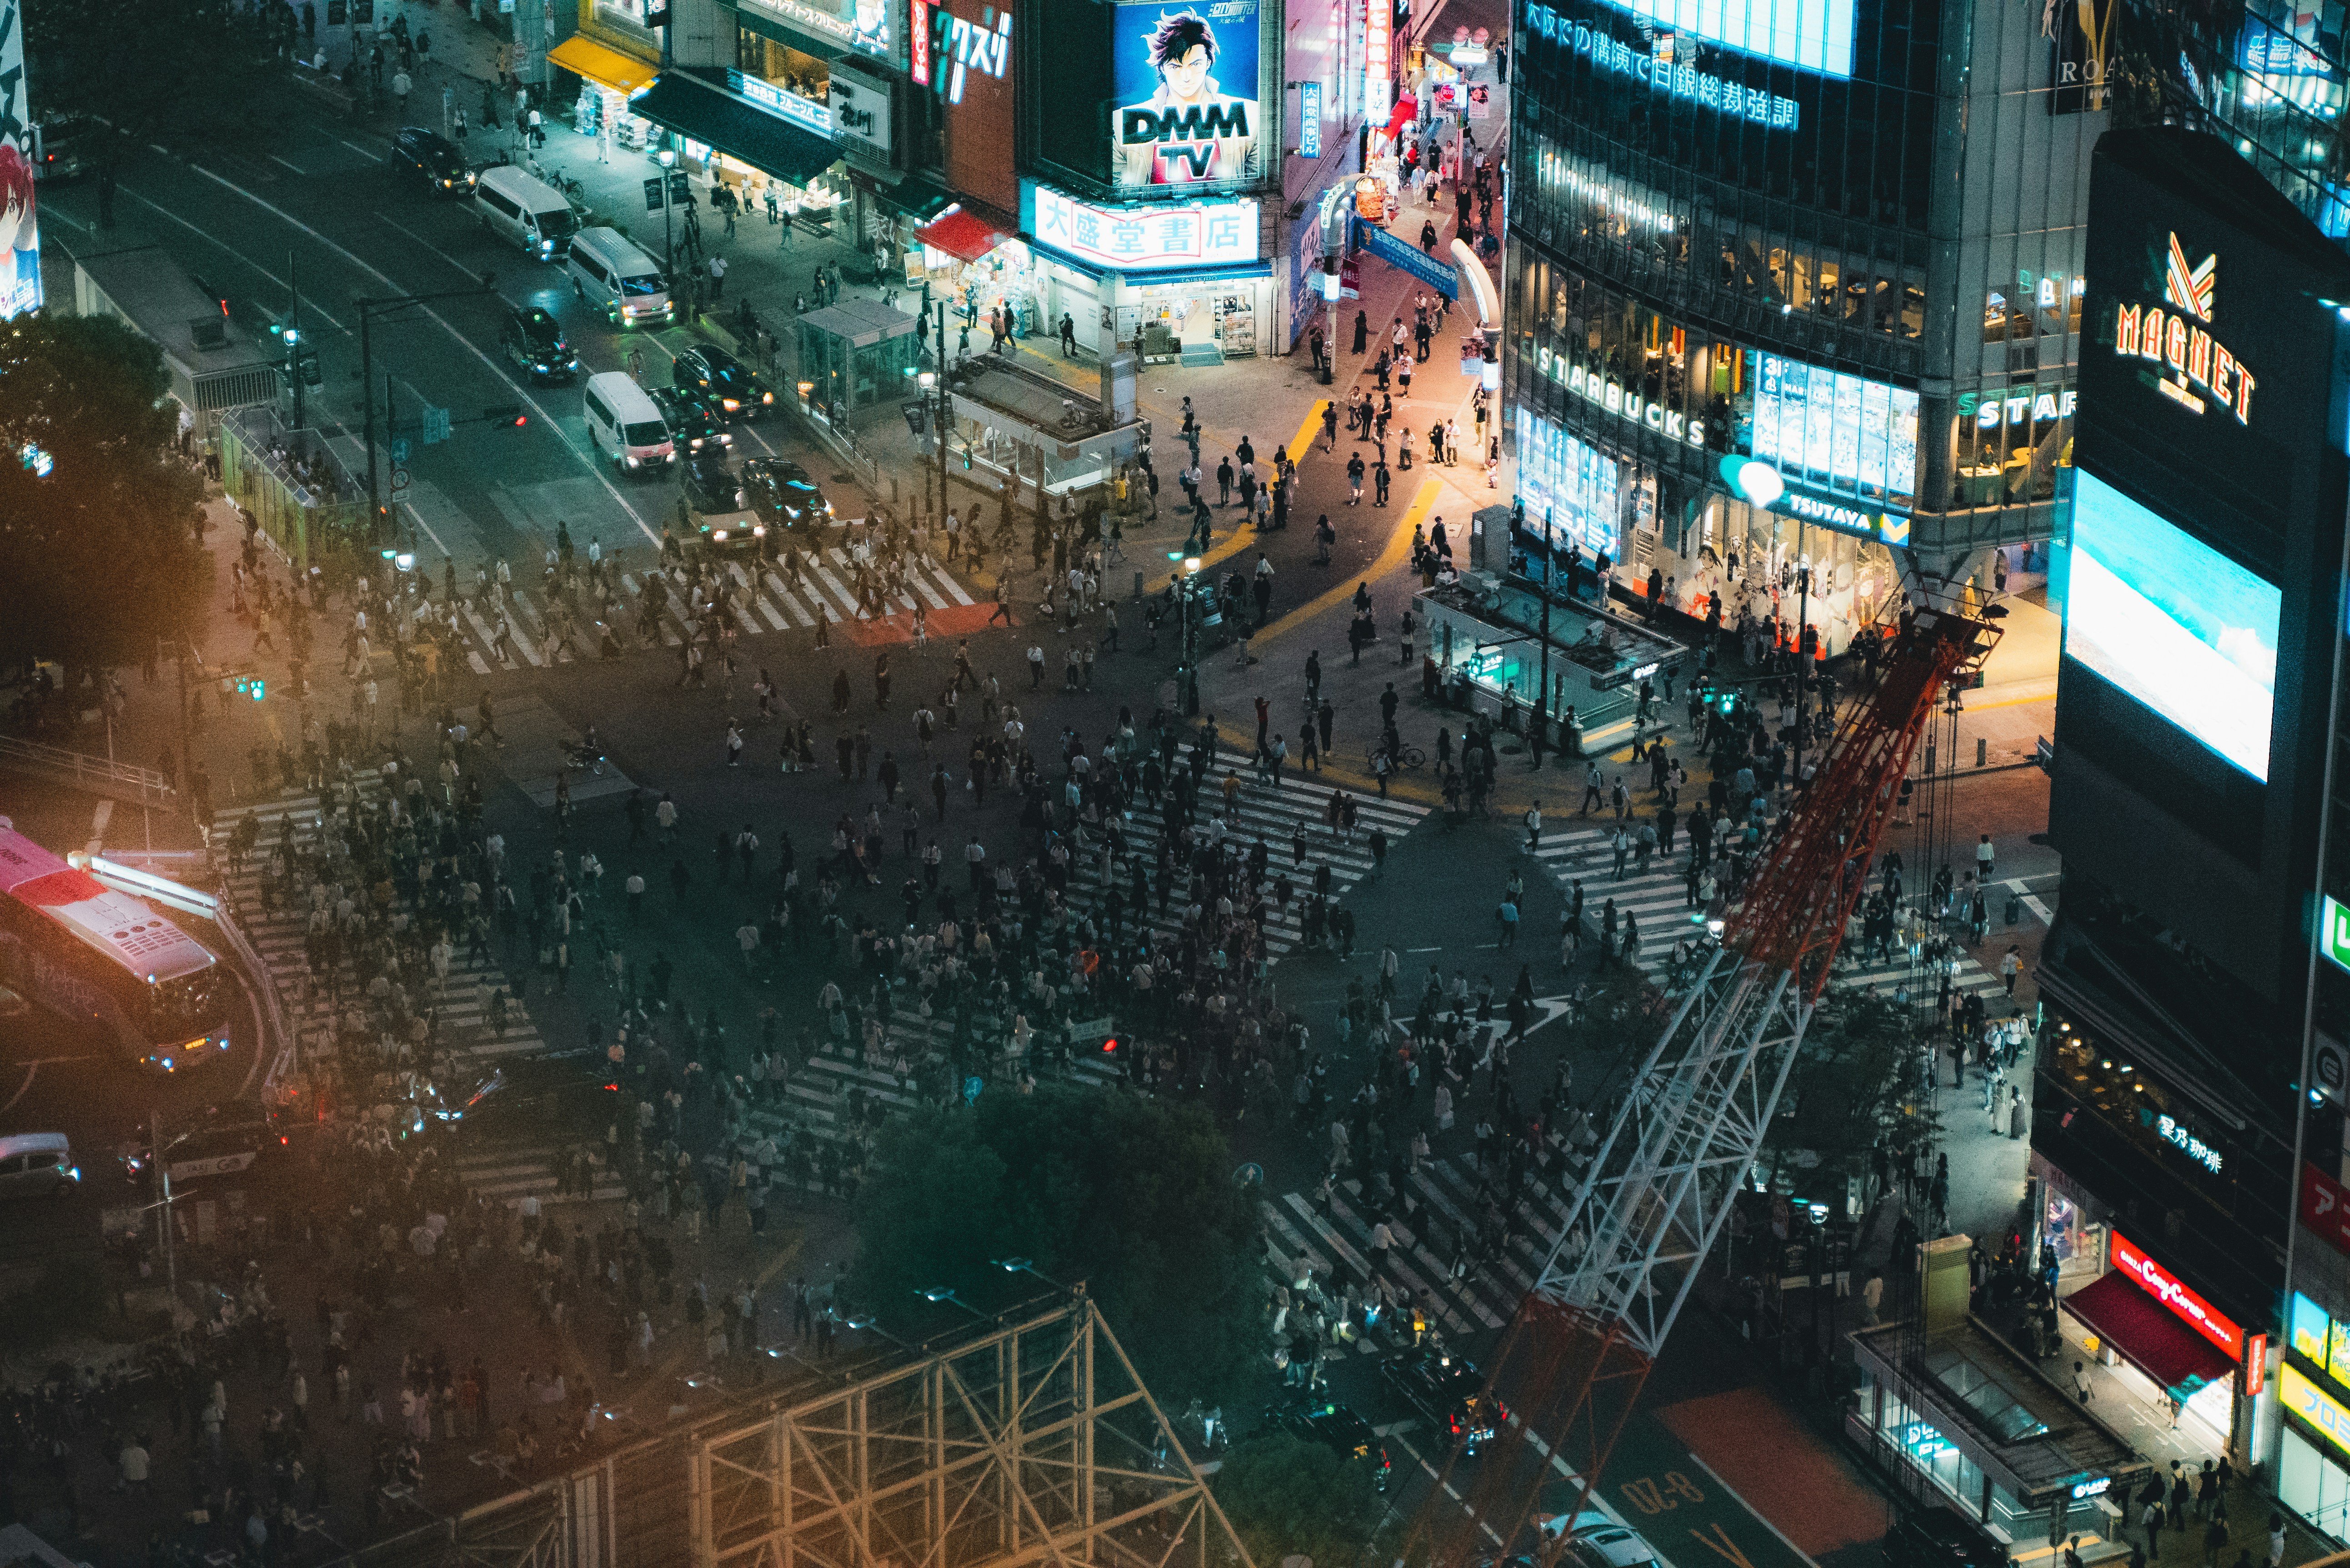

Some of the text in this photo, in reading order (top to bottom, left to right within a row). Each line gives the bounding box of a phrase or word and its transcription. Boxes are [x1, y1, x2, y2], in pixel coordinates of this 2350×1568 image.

[950, 11, 1010, 103] クスリ
[1121, 101, 1250, 146] DMM
[1306, 87, 1317, 153] 大盛堂商事ビル
[1158, 141, 1215, 180] TV
[1045, 200, 1241, 253] 大盛堂書店
[2117, 303, 2255, 425] MAGNET
[1539, 347, 1706, 446] STARBUCKS
[1789, 494, 1871, 530] TSUTAYA
[2159, 1115, 2222, 1174] 星乃珈琲
[2120, 1250, 2142, 1273] GINZA
